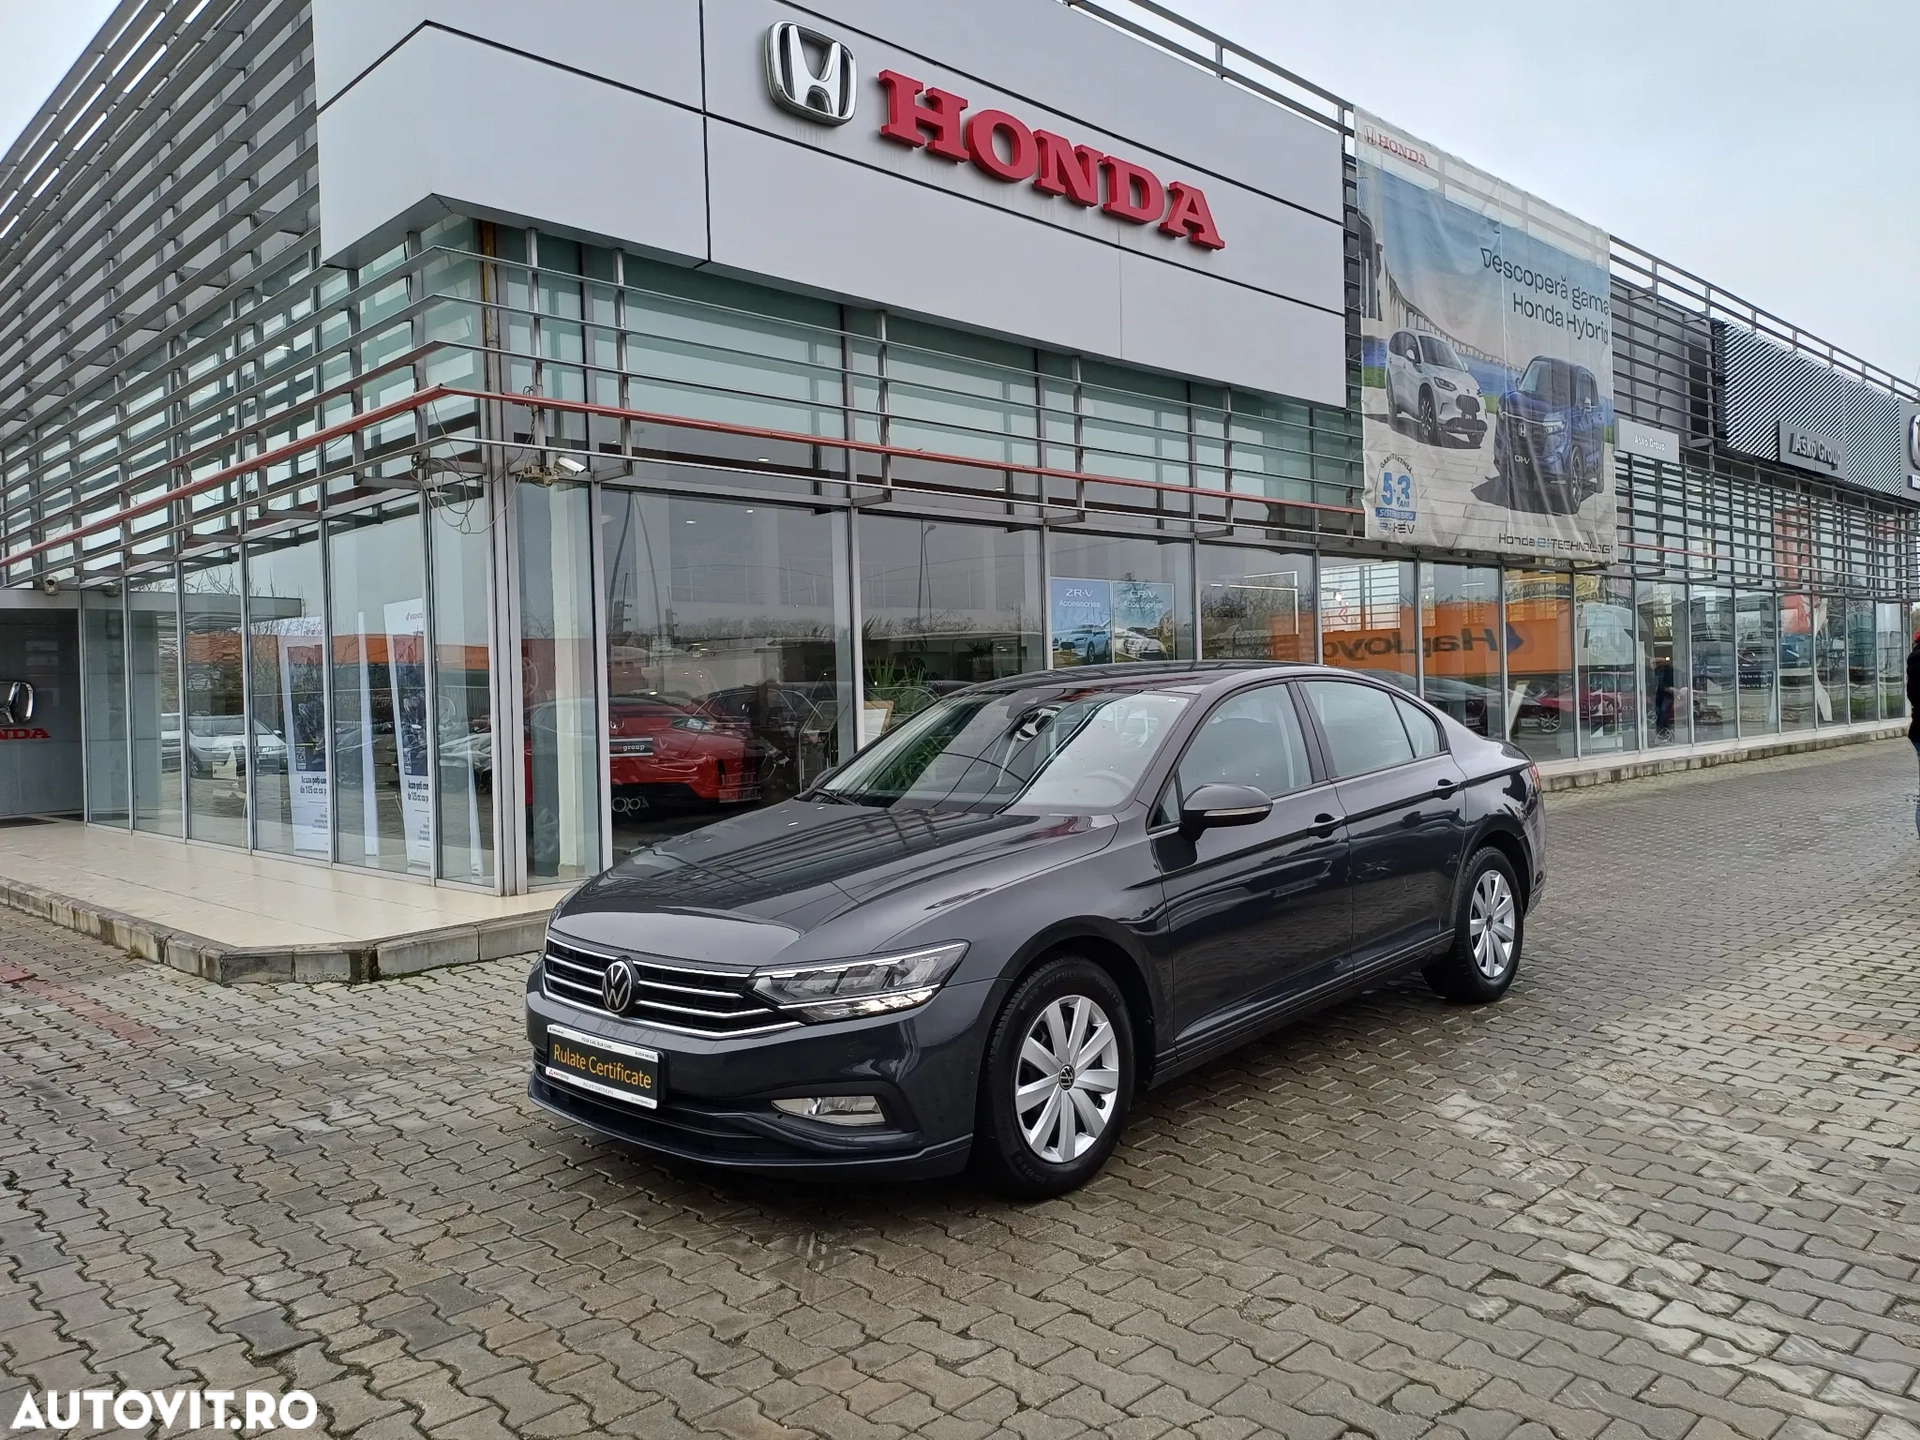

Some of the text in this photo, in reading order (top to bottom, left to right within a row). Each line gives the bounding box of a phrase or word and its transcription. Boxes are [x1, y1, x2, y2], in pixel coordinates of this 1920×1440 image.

[877, 69, 1225, 251] HONDA
[1378, 133, 1430, 168] HONDA
[1571, 287, 1610, 315] gama
[1513, 293, 1609, 346] Honda Hybrid
[1793, 432, 1843, 468] Asko Group
[1498, 533, 1535, 547] Honda
[1058, 599, 1101, 608] Accessories
[553, 1043, 652, 1089] Rulate Certificate
